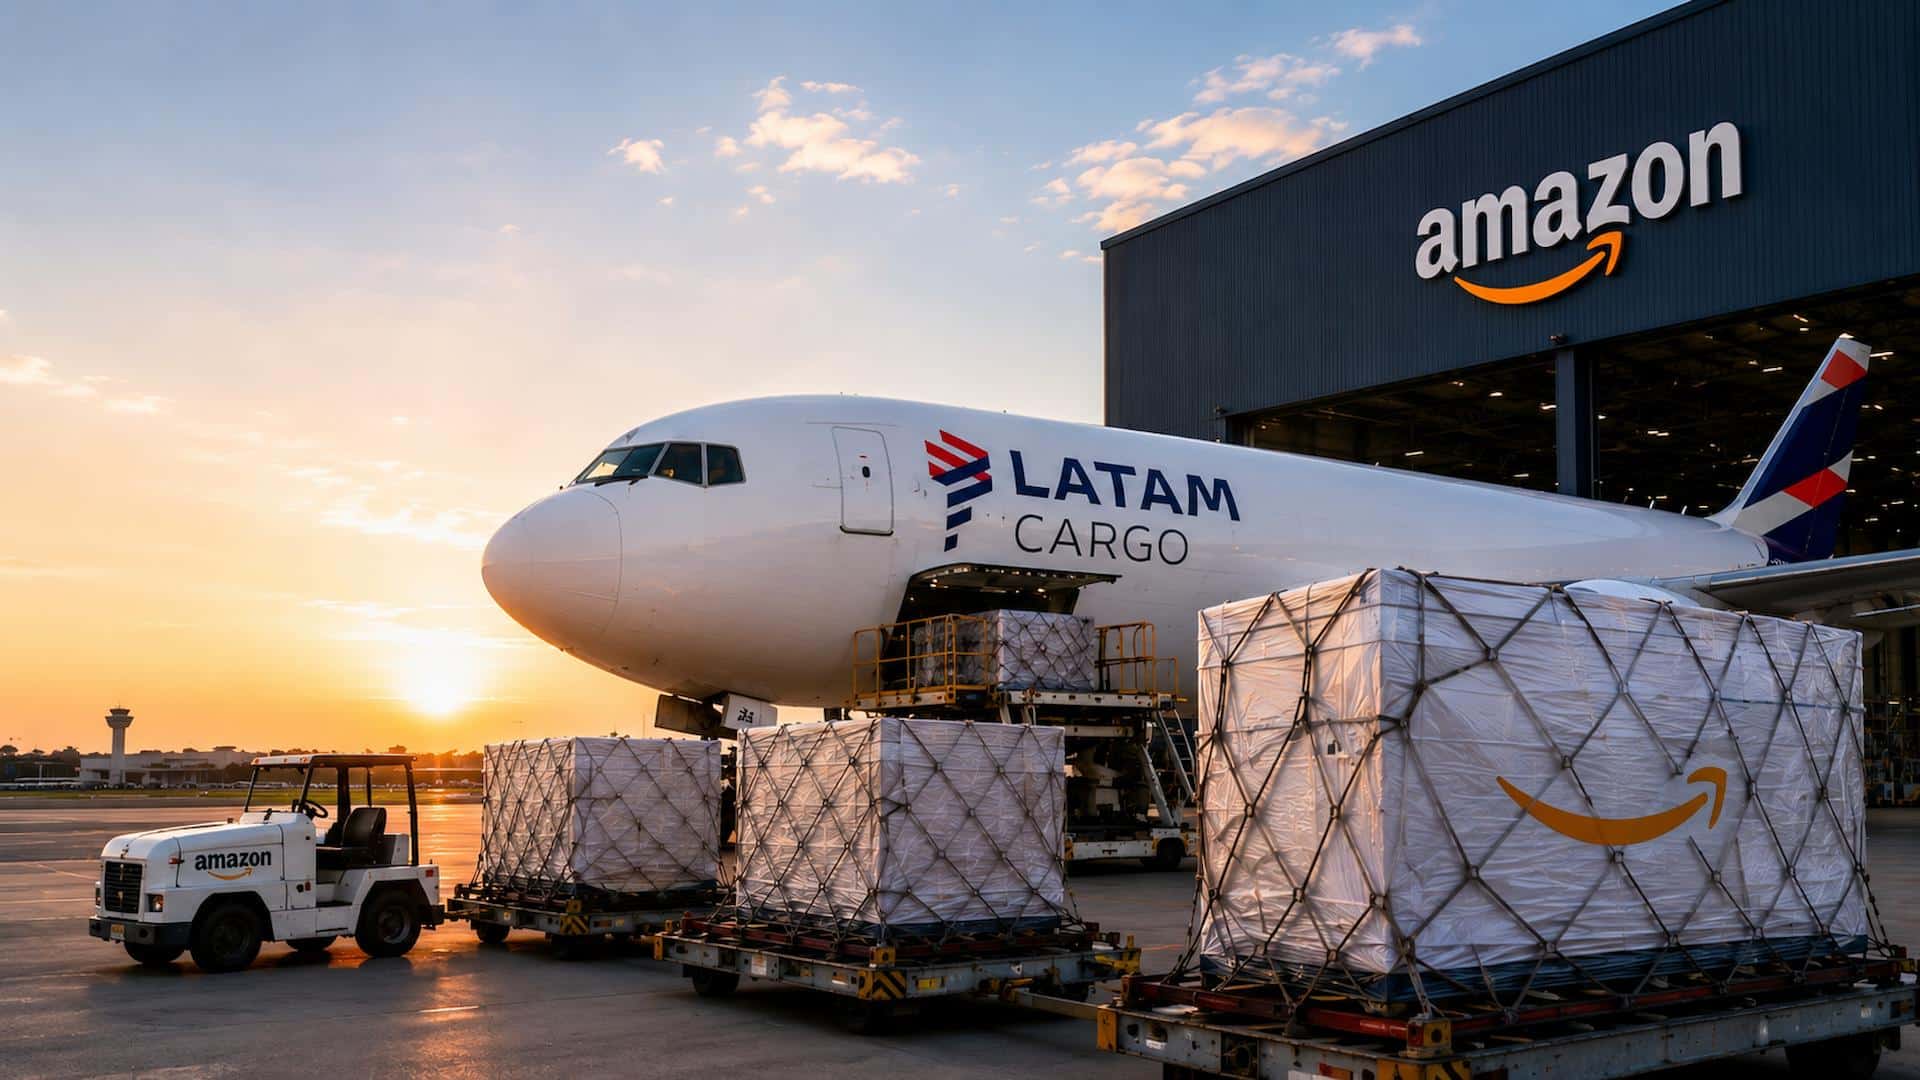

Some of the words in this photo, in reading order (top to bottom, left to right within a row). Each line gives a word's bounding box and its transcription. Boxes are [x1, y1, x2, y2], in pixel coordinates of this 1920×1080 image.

[1415, 121, 1743, 280] amazon
[1009, 449, 1241, 522] LATAM
[1014, 513, 1189, 566] CARGO
[194, 850, 272, 871] amazon
